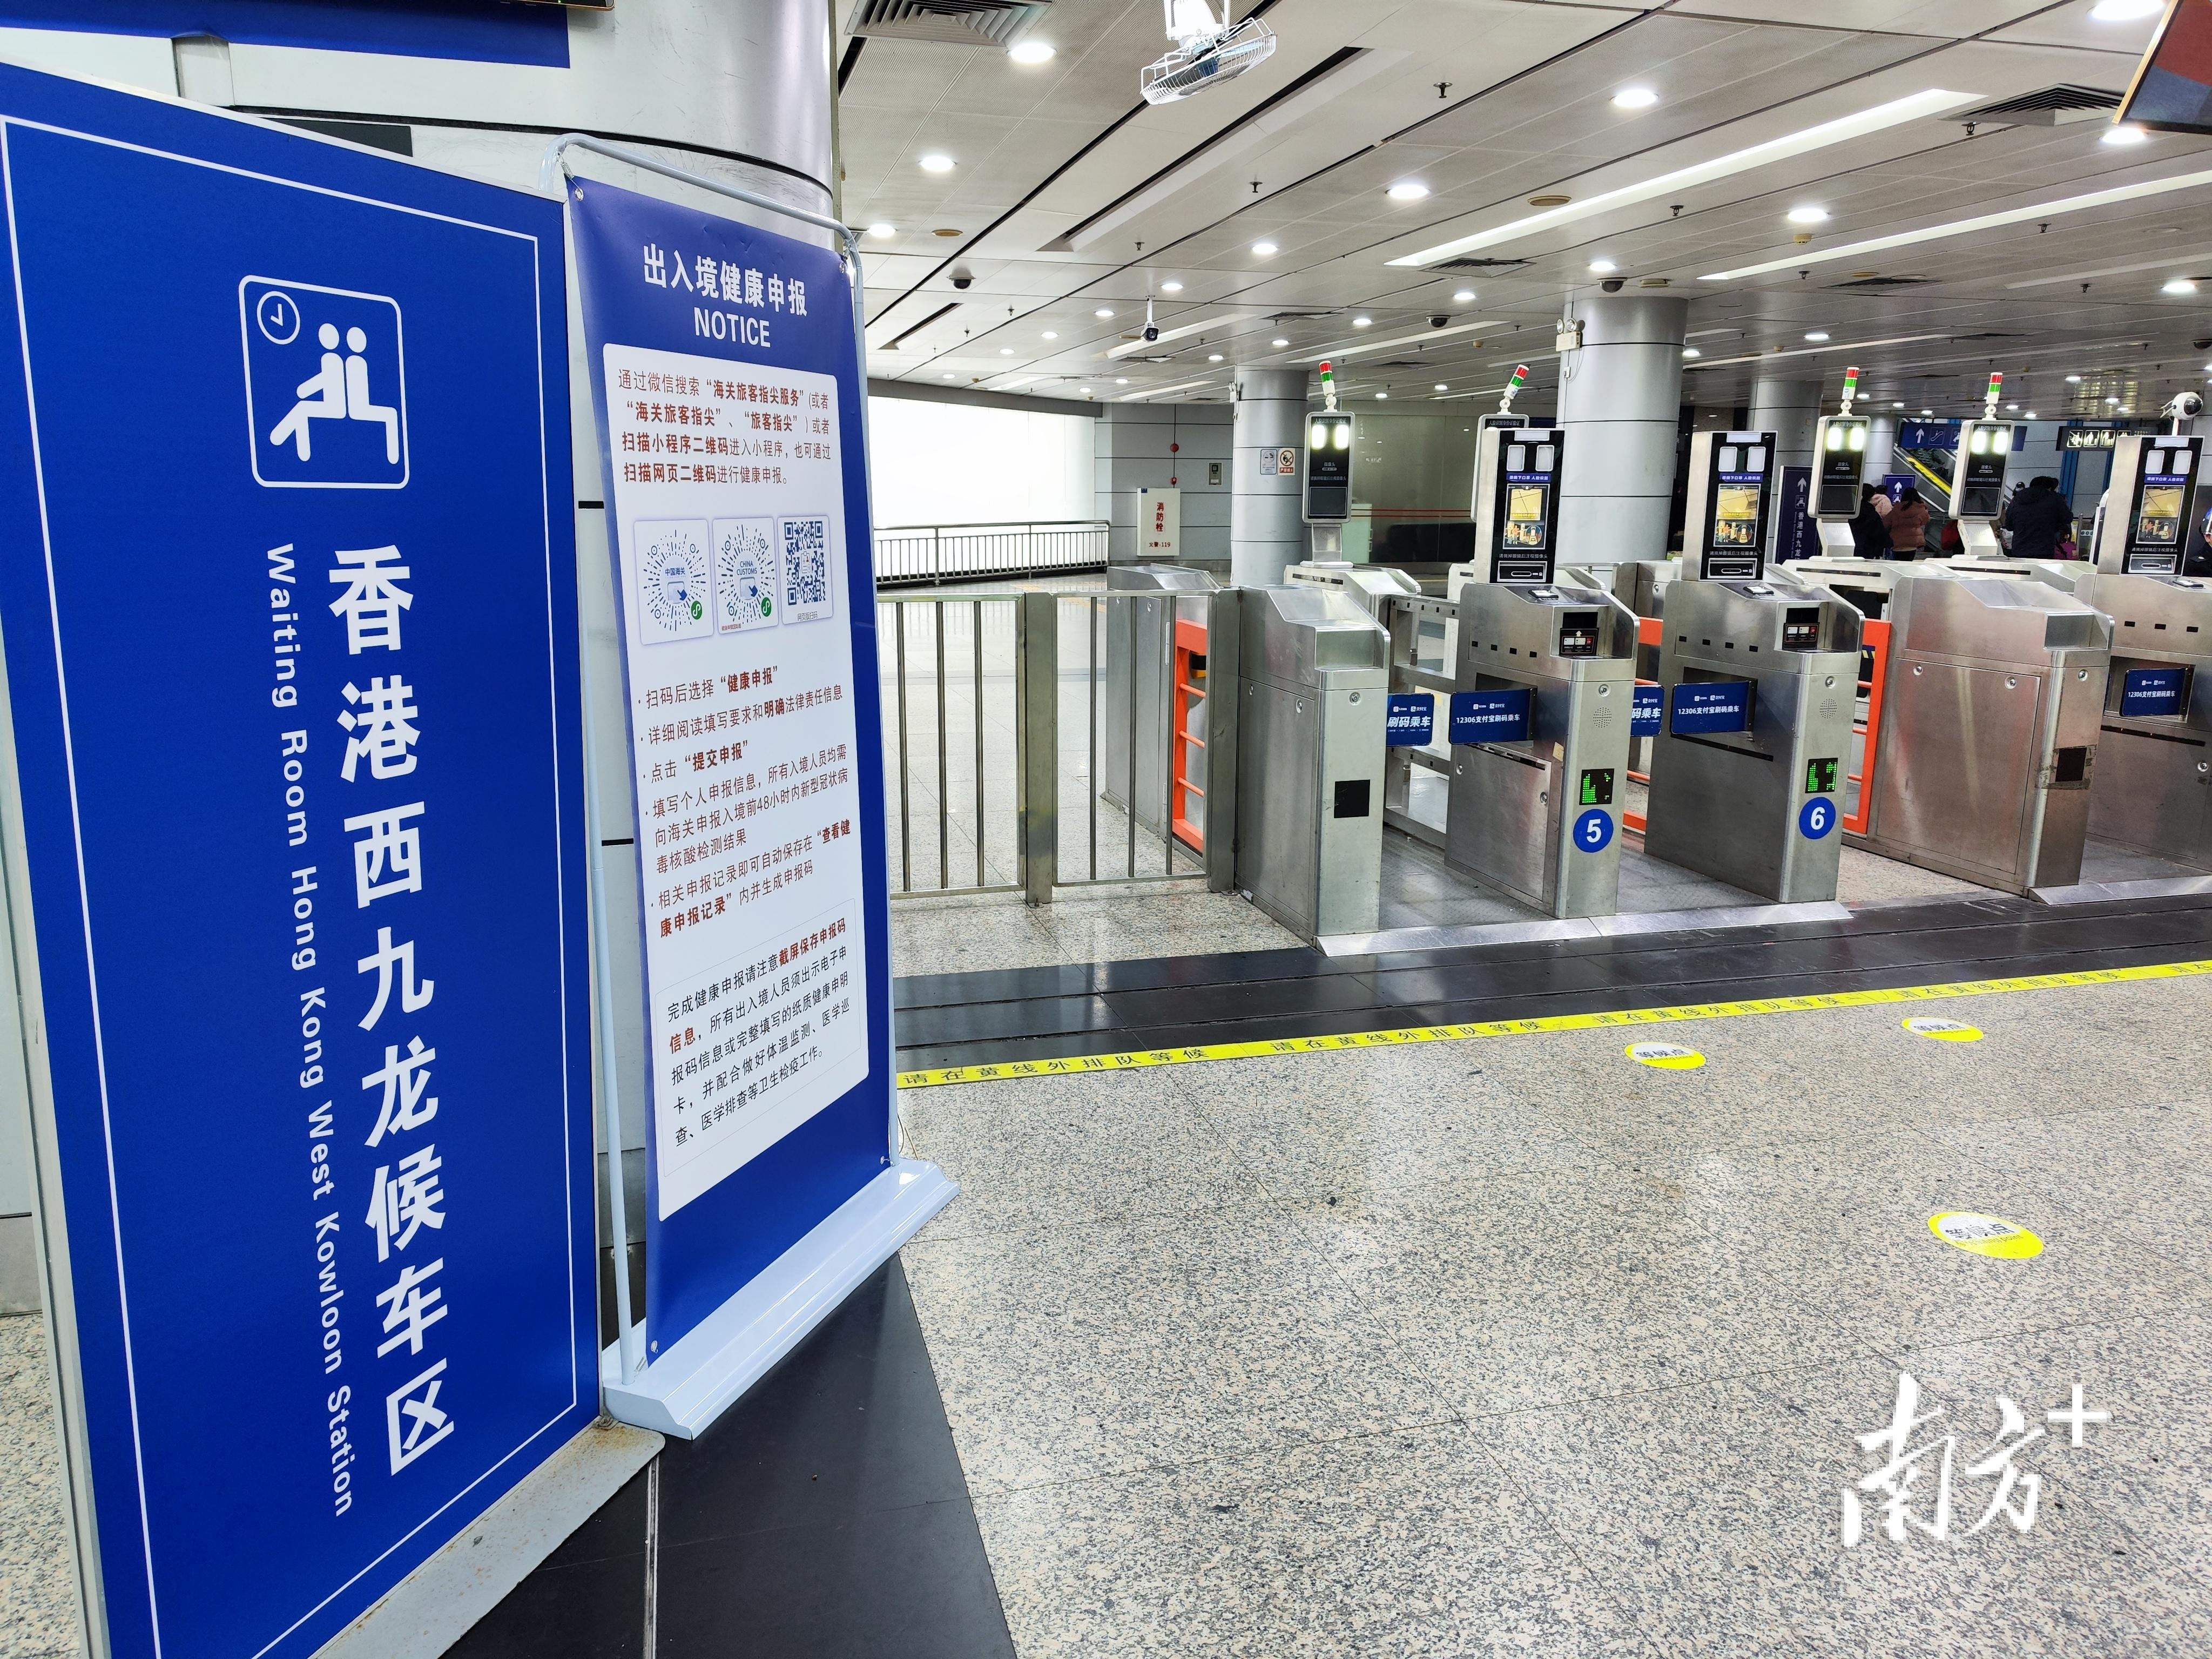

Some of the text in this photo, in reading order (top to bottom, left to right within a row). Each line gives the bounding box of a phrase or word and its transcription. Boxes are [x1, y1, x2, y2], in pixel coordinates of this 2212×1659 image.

[643, 243, 807, 316] 出入境健康申报
[694, 307, 771, 347] NOTICE
[623, 431, 831, 460] 扫描小程序二维码进入小程序，也可通过
[624, 462, 787, 485] 扫描网页二维码进行健康申报。
[1156, 502, 1164, 532] 消防栓
[665, 567, 686, 576] 中国海关
[737, 568, 757, 576] CUSTOMS
[1387, 716, 1431, 727] 刷码乘车
[1456, 714, 1520, 723] 12306支付宝刷码乘车
[1678, 705, 1739, 714] 12306支付宝刷码乘车
[655, 767, 848, 848] 向海关申报入境前48小时内新型冠状病
[1811, 806, 1826, 830] 6
[1586, 818, 1602, 843] 5
[656, 828, 746, 875] 毒核酸检测结果
[668, 918, 846, 1023] 完成健康申报请注意截屏保存申报码
[1896, 972, 2125, 999] 请在黄线外排队等候
[328, 544, 454, 1476] 香港西九龙候车区
[669, 945, 847, 1055] 信息，所有出入境人员须出示电子申
[1591, 996, 1841, 1024] 请在黄线外排队等候
[267, 543, 355, 1518] Waiting Room Hong Kong West Kowloon Station
[672, 971, 848, 1086] 报码信息或完整填写的纸质健康申明
[1270, 1021, 1547, 1052] 请在黄线外排队等候
[674, 997, 850, 1114] 卡，并配合做好体温监测、医学巡
[903, 1048, 1210, 1084] 请在黄线外排队等候
[1636, 1049, 1687, 1057] 等候点
[676, 1045, 823, 1148] 查、医学排查等卫生检疫工作。
